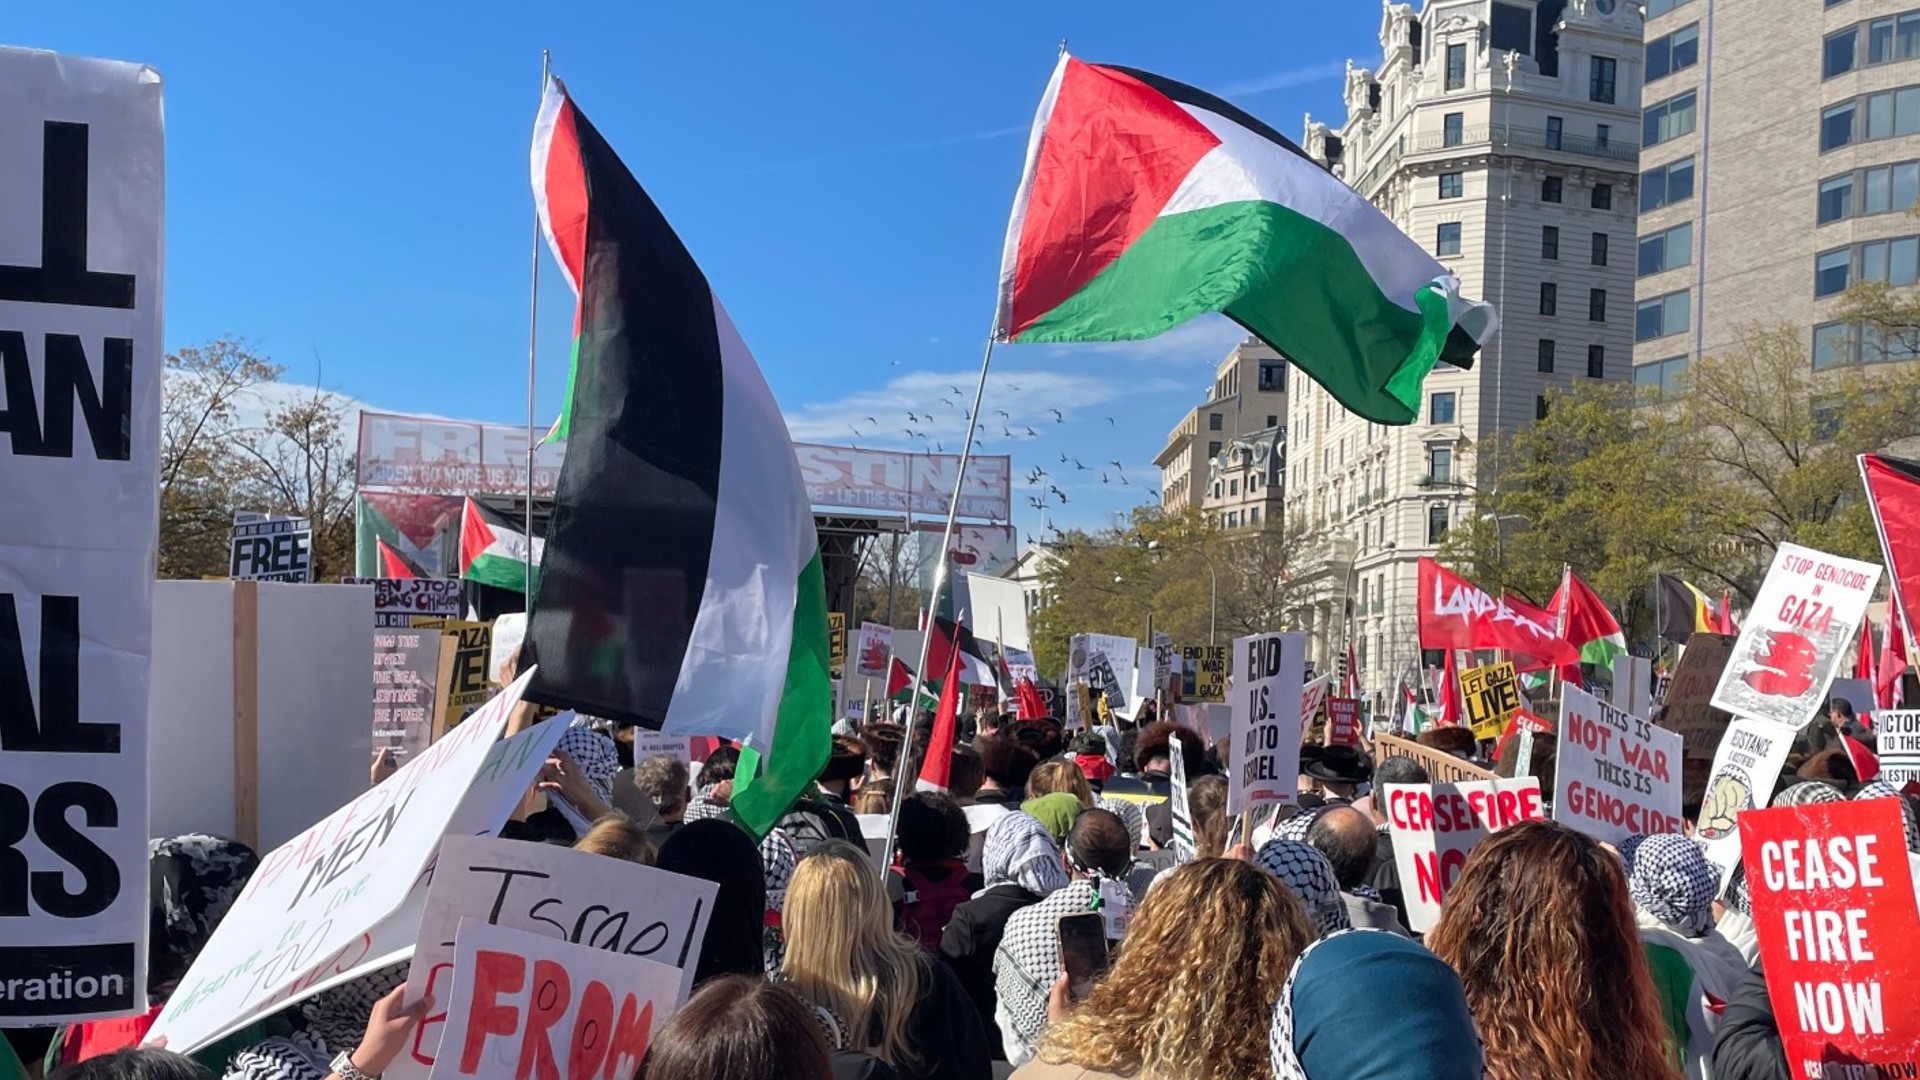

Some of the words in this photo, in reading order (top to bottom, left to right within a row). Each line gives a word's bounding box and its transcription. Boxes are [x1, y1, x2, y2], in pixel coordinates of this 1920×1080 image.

[798, 448, 1002, 501] STINE
[864, 490, 887, 506] THE
[232, 531, 309, 577] FREE
[1783, 554, 1814, 574] STOP
[1815, 563, 1870, 592] GENOCIDE
[411, 579, 457, 595] STOP
[1812, 584, 1824, 597] IN
[1778, 594, 1834, 635] GAZA
[1184, 647, 1202, 659] END
[1206, 647, 1225, 659] THE
[1202, 660, 1224, 672] WAR
[1248, 636, 1281, 682] END
[1200, 685, 1224, 697] GAZA
[1211, 674, 1224, 683] ON
[1463, 676, 1483, 697] LET
[1485, 665, 1514, 687] GAZA
[1250, 685, 1276, 725] U.S.
[1466, 679, 1521, 725] LIVE!
[1598, 701, 1628, 732] THIS
[1635, 719, 1651, 742] IS
[1245, 727, 1257, 757] AID
[1259, 725, 1278, 750] TO
[1569, 712, 1611, 755] NOT
[1620, 738, 1670, 783] WAR
[1884, 736, 1895, 750] TO
[1900, 735, 1920, 750] THE
[1243, 755, 1278, 789] ISRAEL
[1595, 758, 1631, 789] THIS
[1634, 772, 1652, 795] IS
[247, 689, 515, 901] PALESTINIAN
[1390, 787, 1545, 833] CEASEFIRE
[1568, 781, 1680, 835] GENOCIDE
[287, 788, 416, 913] MEN
[1761, 834, 1884, 892] CEASE
[1414, 848, 1472, 905] NO
[167, 949, 262, 1023] deserve
[277, 919, 307, 949] to
[324, 872, 371, 917] live
[1784, 908, 1874, 963] FIRE
[239, 918, 333, 1008] TOO
[459, 950, 653, 1080] FROM
[1793, 982, 1884, 1035] NOW
